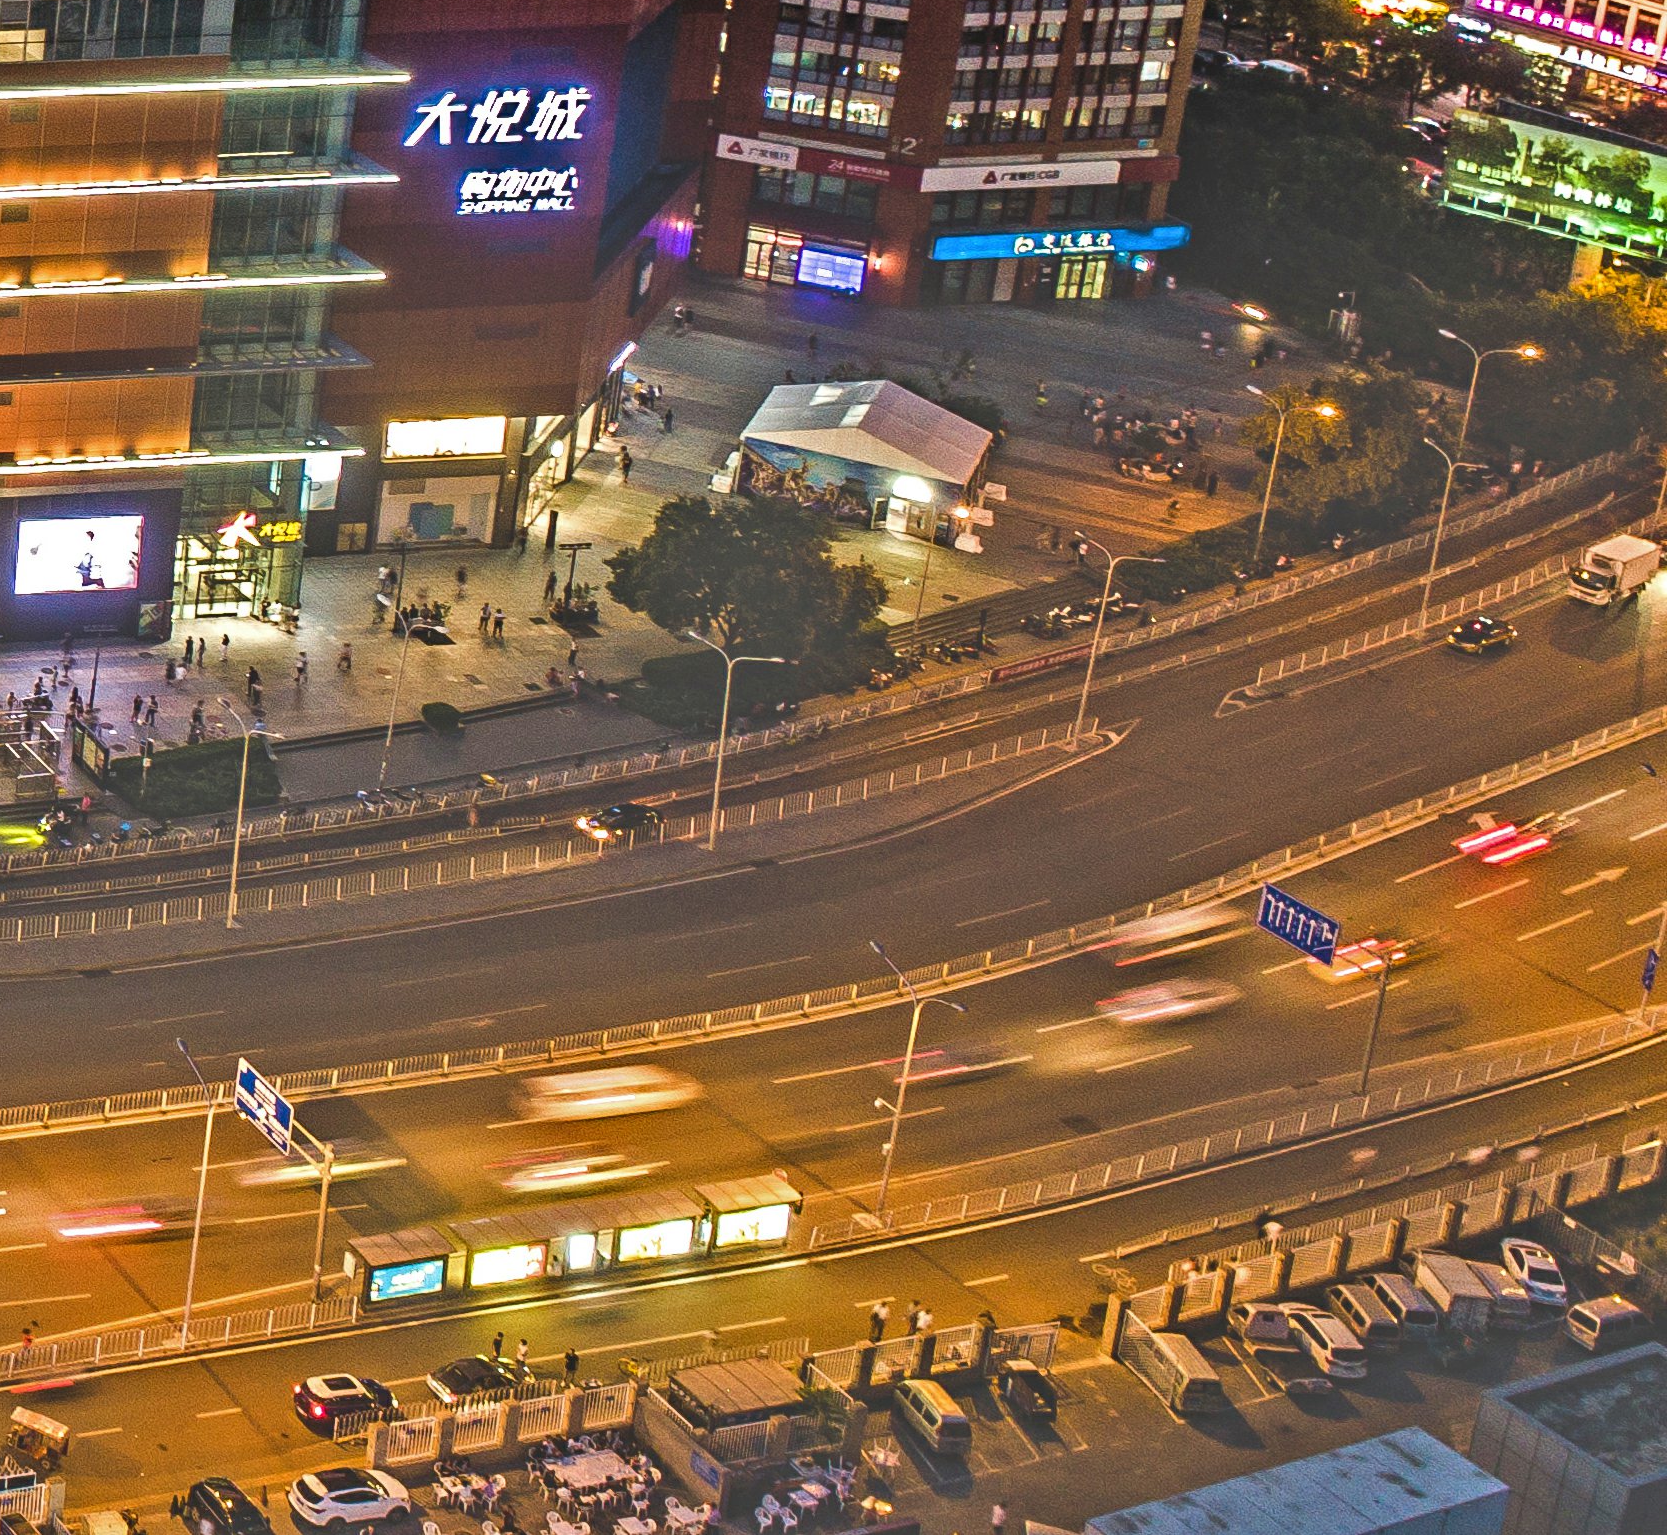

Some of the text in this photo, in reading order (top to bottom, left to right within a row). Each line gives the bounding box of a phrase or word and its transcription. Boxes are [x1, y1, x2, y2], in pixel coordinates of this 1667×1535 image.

[403, 87, 592, 146] 大悦城
[460, 166, 579, 200] 购物中心
[457, 196, 576, 215] SHOPPING MALL
